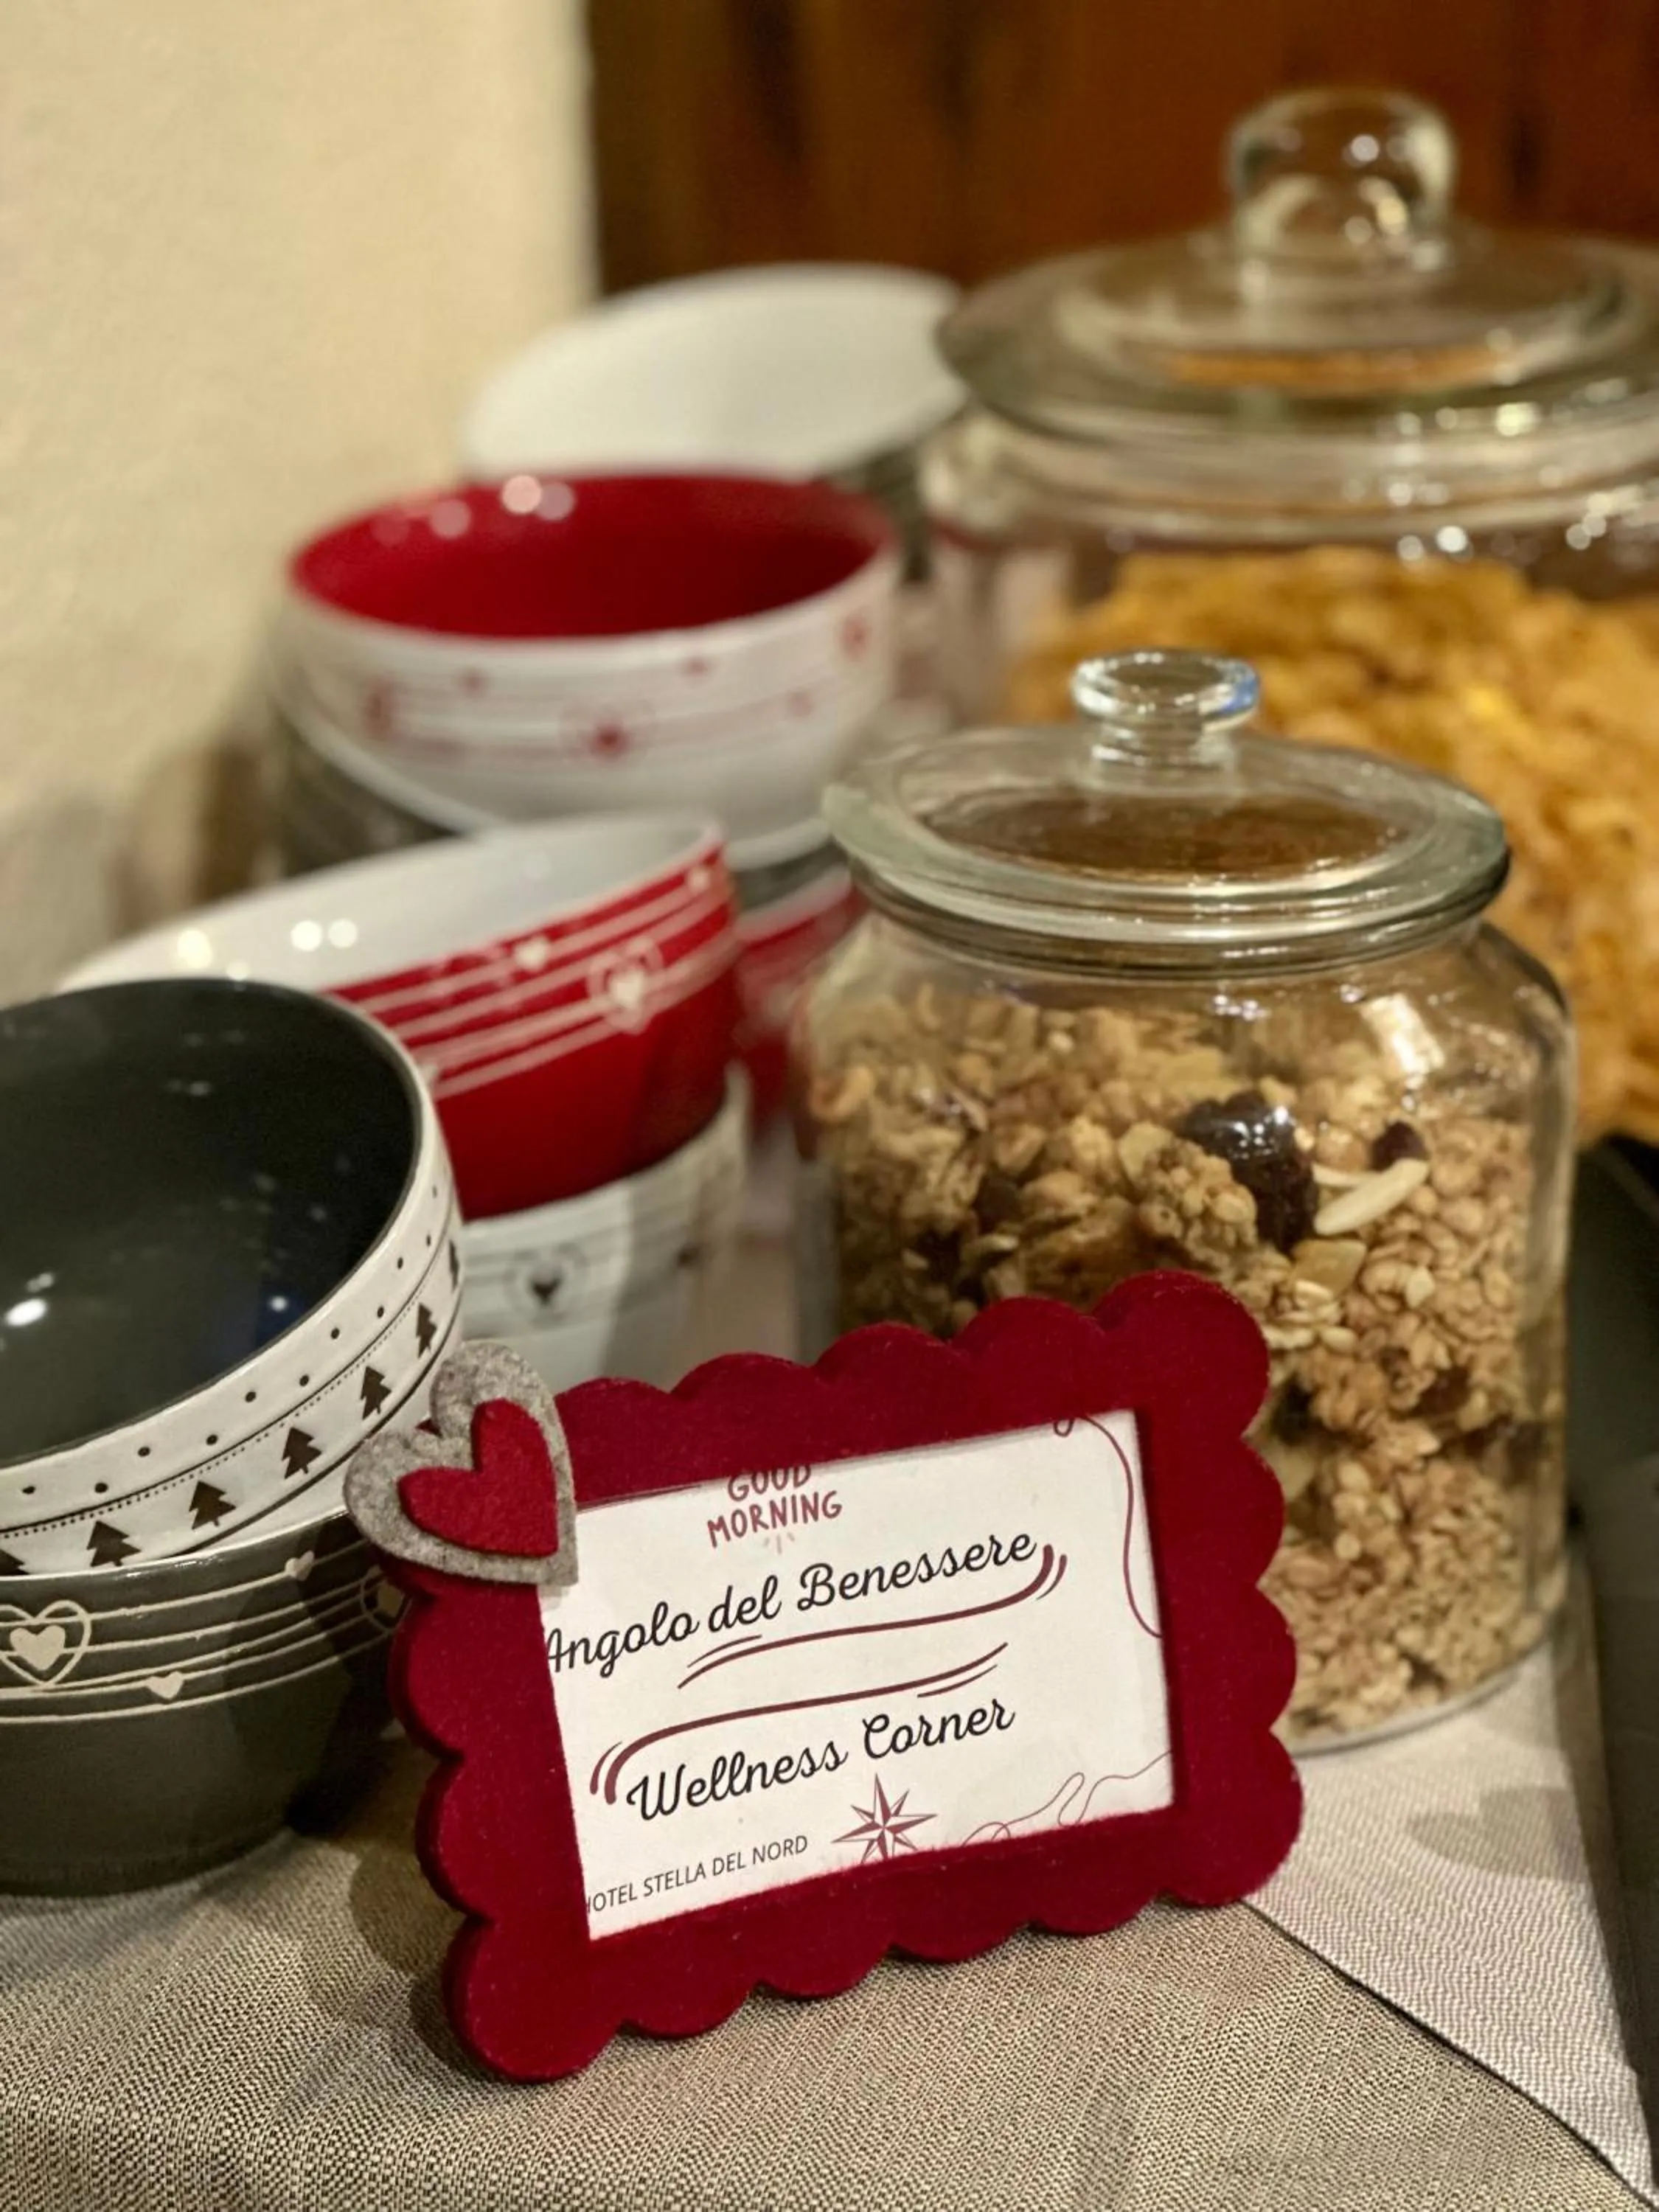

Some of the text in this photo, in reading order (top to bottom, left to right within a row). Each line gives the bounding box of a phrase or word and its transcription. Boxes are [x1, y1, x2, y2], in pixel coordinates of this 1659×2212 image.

[728, 1465, 812, 1502] GOOD
[707, 1490, 842, 1548] MORNING
[547, 1532, 1037, 1678] Angolo del Benessere
[626, 1698, 1016, 1820] Wellness Corner
[643, 1862, 706, 1898] STELLA
[712, 1851, 747, 1877] DEL
[752, 1834, 808, 1865] NORD
